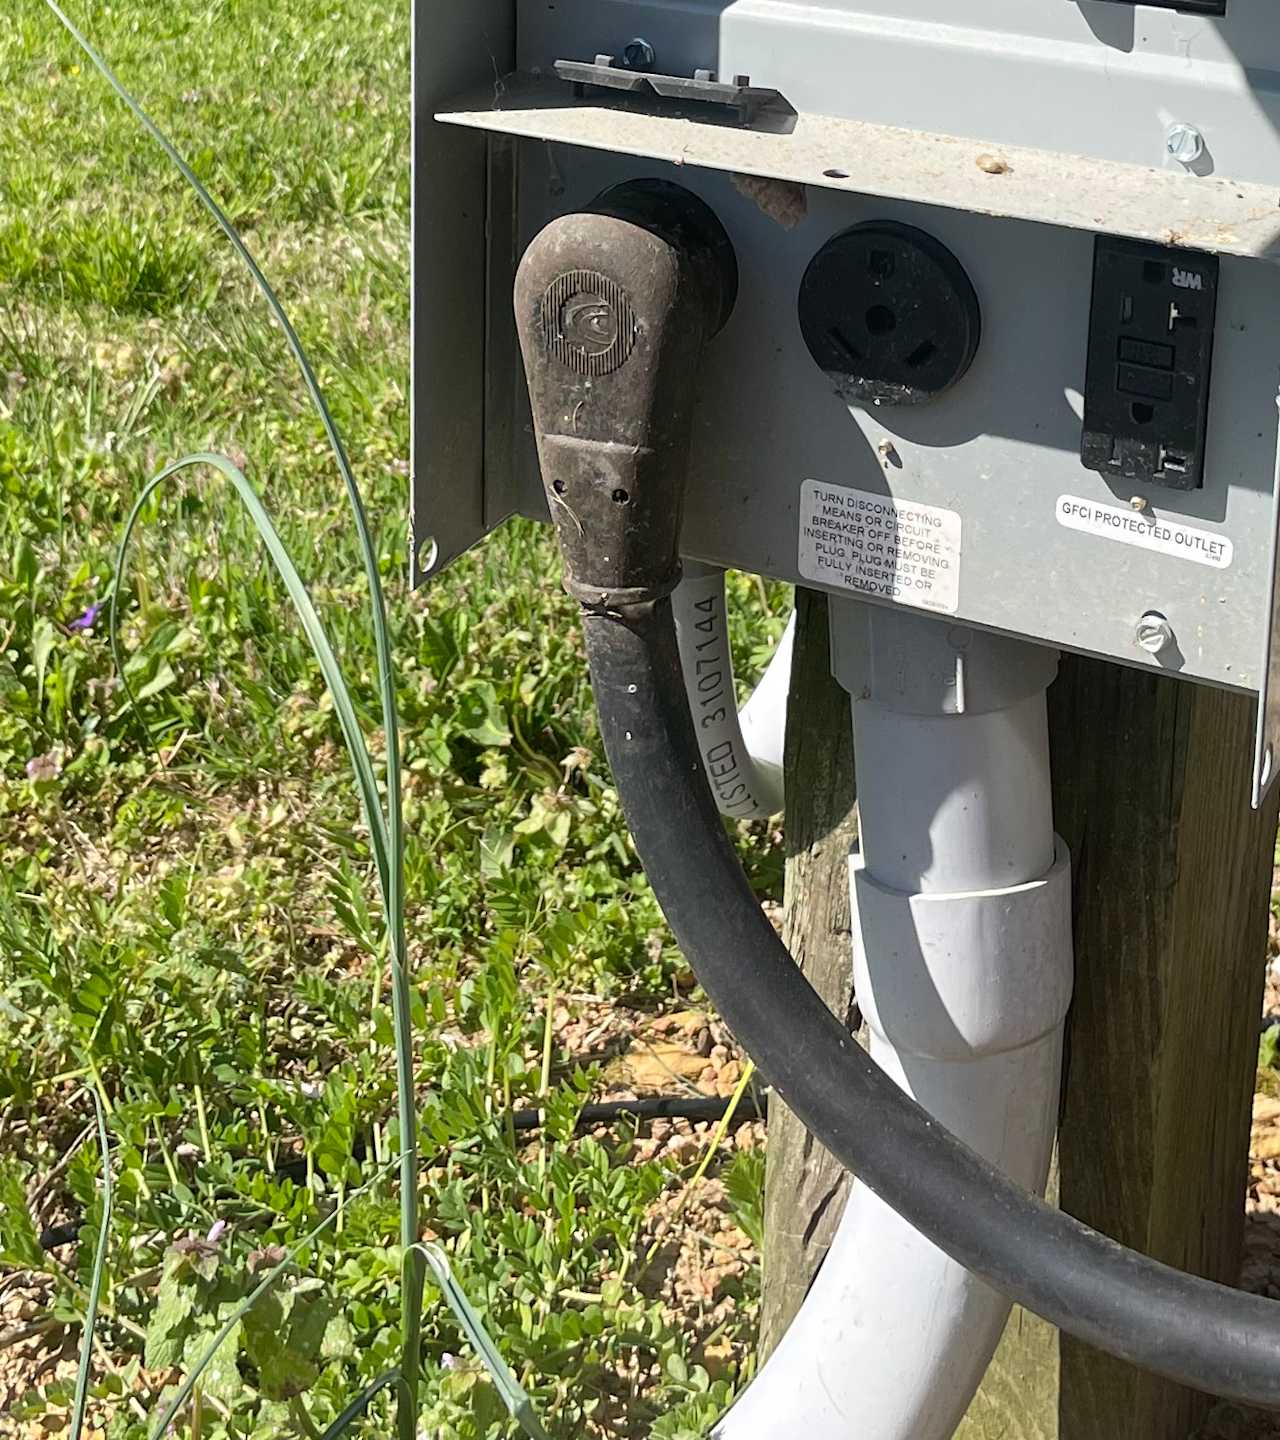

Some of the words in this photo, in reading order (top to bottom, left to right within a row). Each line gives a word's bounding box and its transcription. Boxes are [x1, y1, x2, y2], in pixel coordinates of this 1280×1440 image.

[1171, 266, 1202, 291] WR
[813, 489, 844, 506] TURN
[847, 496, 943, 528] DISCONNECTING
[822, 505, 862, 523] MEANS
[865, 513, 883, 527] OR
[885, 519, 931, 539] CIRCUIT
[803, 526, 864, 550] INSERTING
[867, 541, 884, 554] OR
[887, 545, 950, 570] REMOVING
[812, 515, 865, 535] BREAKER
[868, 528, 891, 542] OFF
[894, 534, 942, 554] BEFORE
[1062, 501, 1092, 520] GFCI
[1094, 510, 1171, 542] PROTECTED
[1174, 531, 1226, 556] OUTLET
[817, 554, 852, 572] FULLY
[855, 564, 912, 586] INSERTED
[914, 579, 933, 591] OR
[852, 550, 882, 567] PLUG
[884, 558, 918, 575] MUST
[920, 566, 936, 580] BE
[844, 574, 902, 597] REMOVED
[694, 595, 727, 729] 3107144
[706, 739, 759, 816] LISTED
